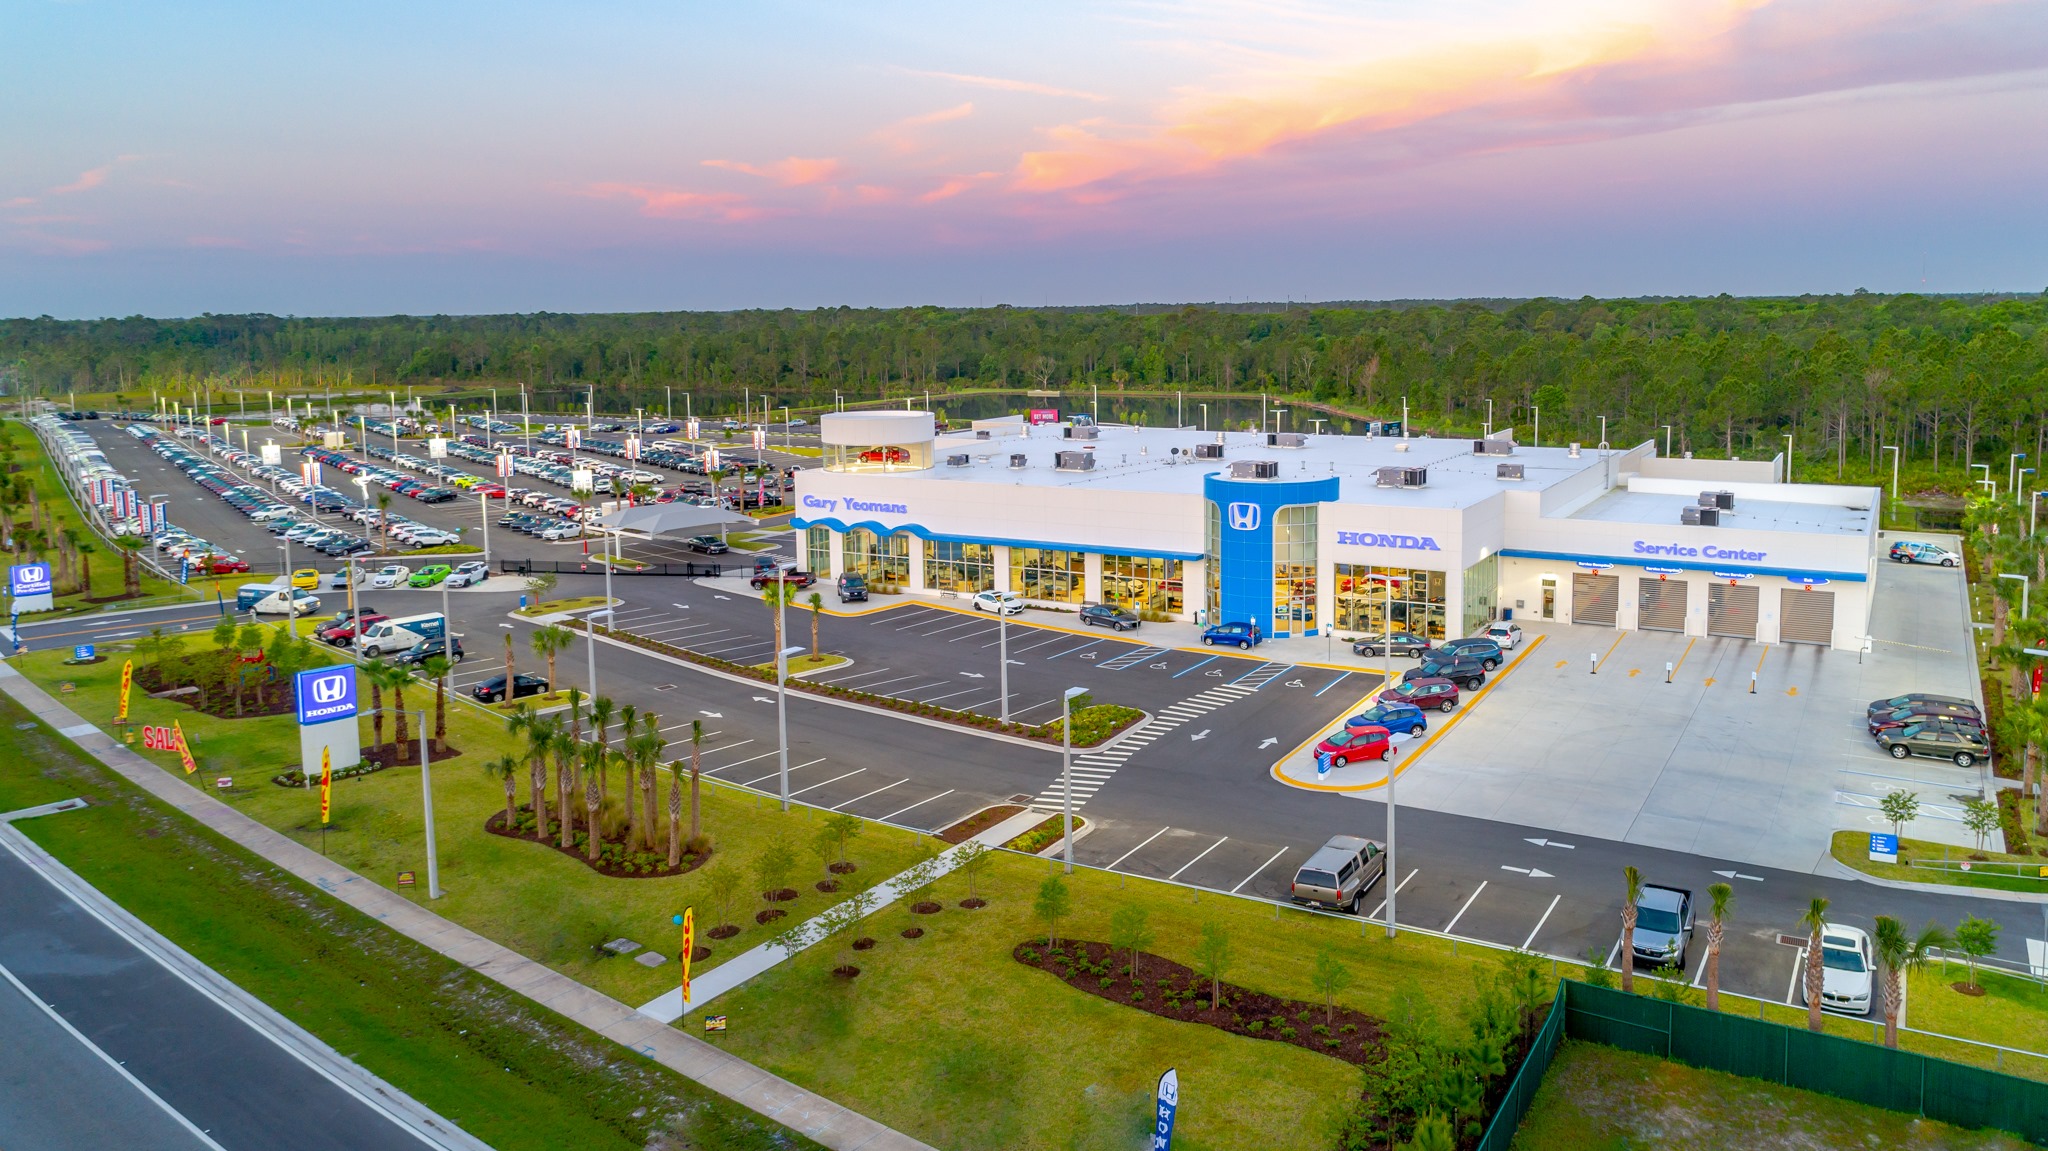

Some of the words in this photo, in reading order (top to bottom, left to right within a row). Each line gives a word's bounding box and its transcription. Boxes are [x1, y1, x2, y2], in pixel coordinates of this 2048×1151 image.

[803, 494, 837, 512] Gary
[842, 497, 907, 514] Yeomans
[1337, 531, 1441, 551] HONDA
[1634, 540, 1698, 557] Service
[1702, 545, 1767, 561] Center
[16, 580, 50, 589] Certified
[16, 586, 51, 594] Pre-Owned
[306, 703, 355, 718] HONDA
